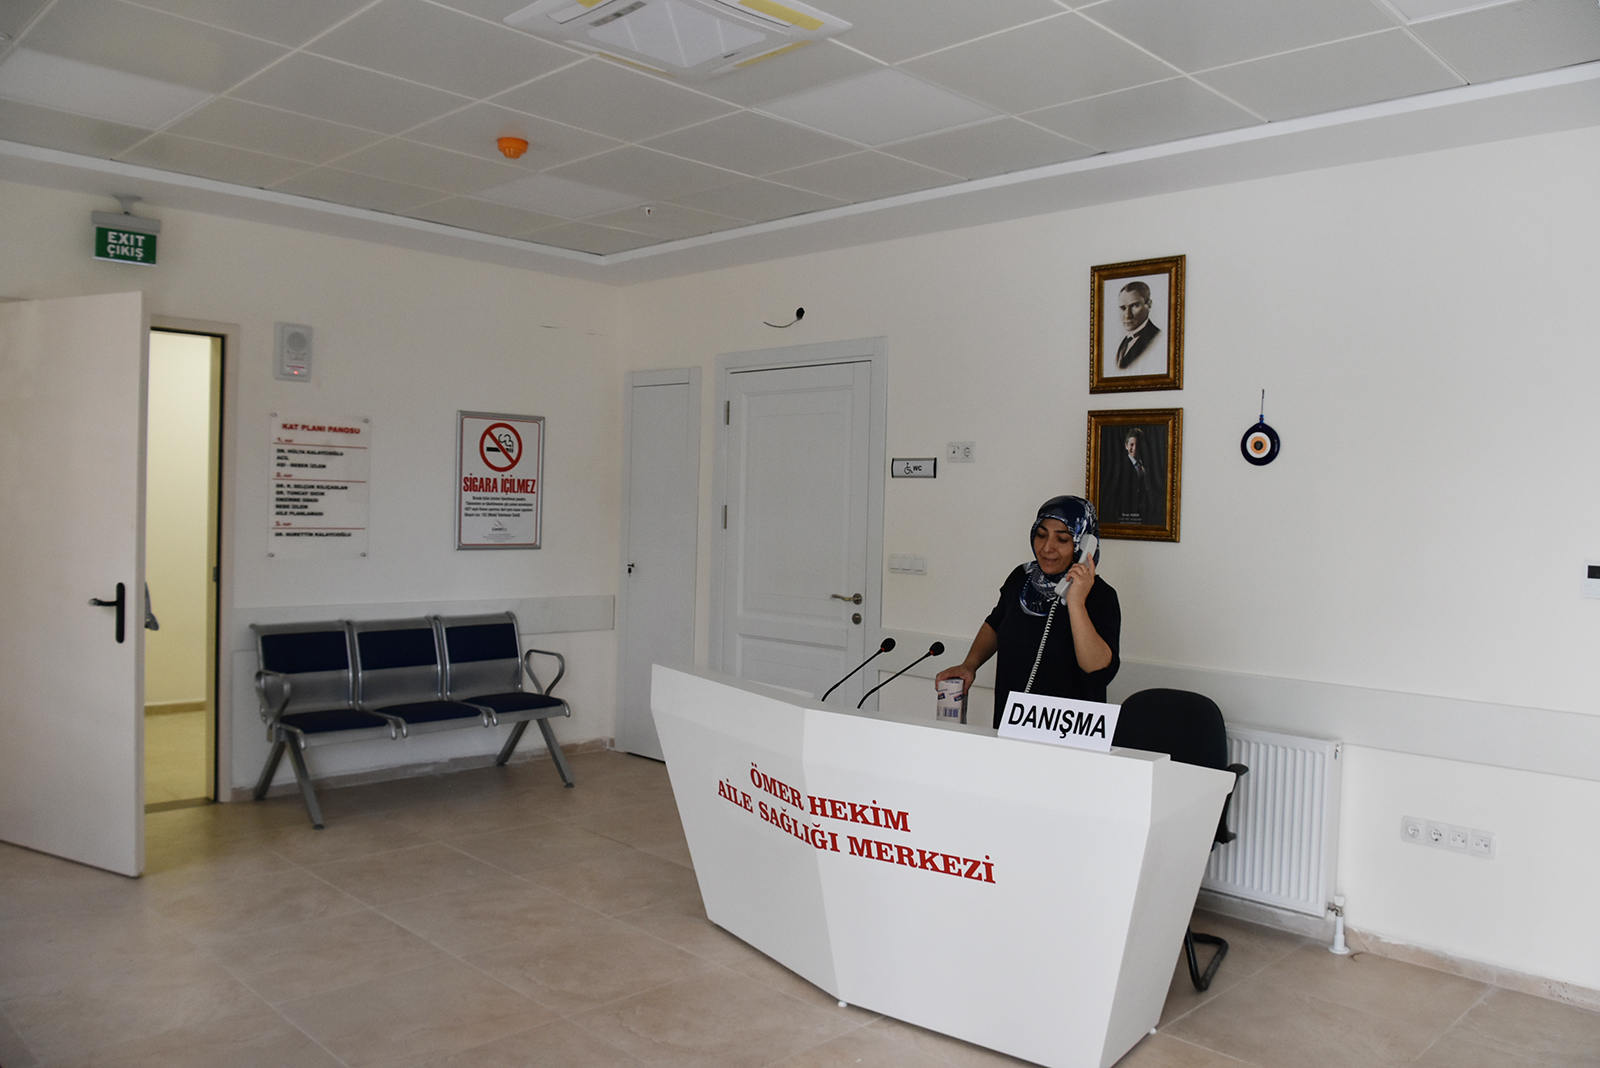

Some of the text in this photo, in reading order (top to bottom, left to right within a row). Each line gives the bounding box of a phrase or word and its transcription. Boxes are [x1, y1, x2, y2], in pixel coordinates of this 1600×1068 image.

[107, 231, 146, 247] EXIT
[106, 244, 144, 261] ÇIKIŞ
[301, 424, 326, 432] PLANI
[327, 425, 361, 434] PANOSU
[463, 473, 536, 495] SİGARA İÇİLMEZ
[1008, 702, 1106, 739] DANIŞMA
[750, 761, 911, 833] ÖMER HEKİM
[717, 778, 997, 884] AİLE SAĞLIĞI MERKEZİ
